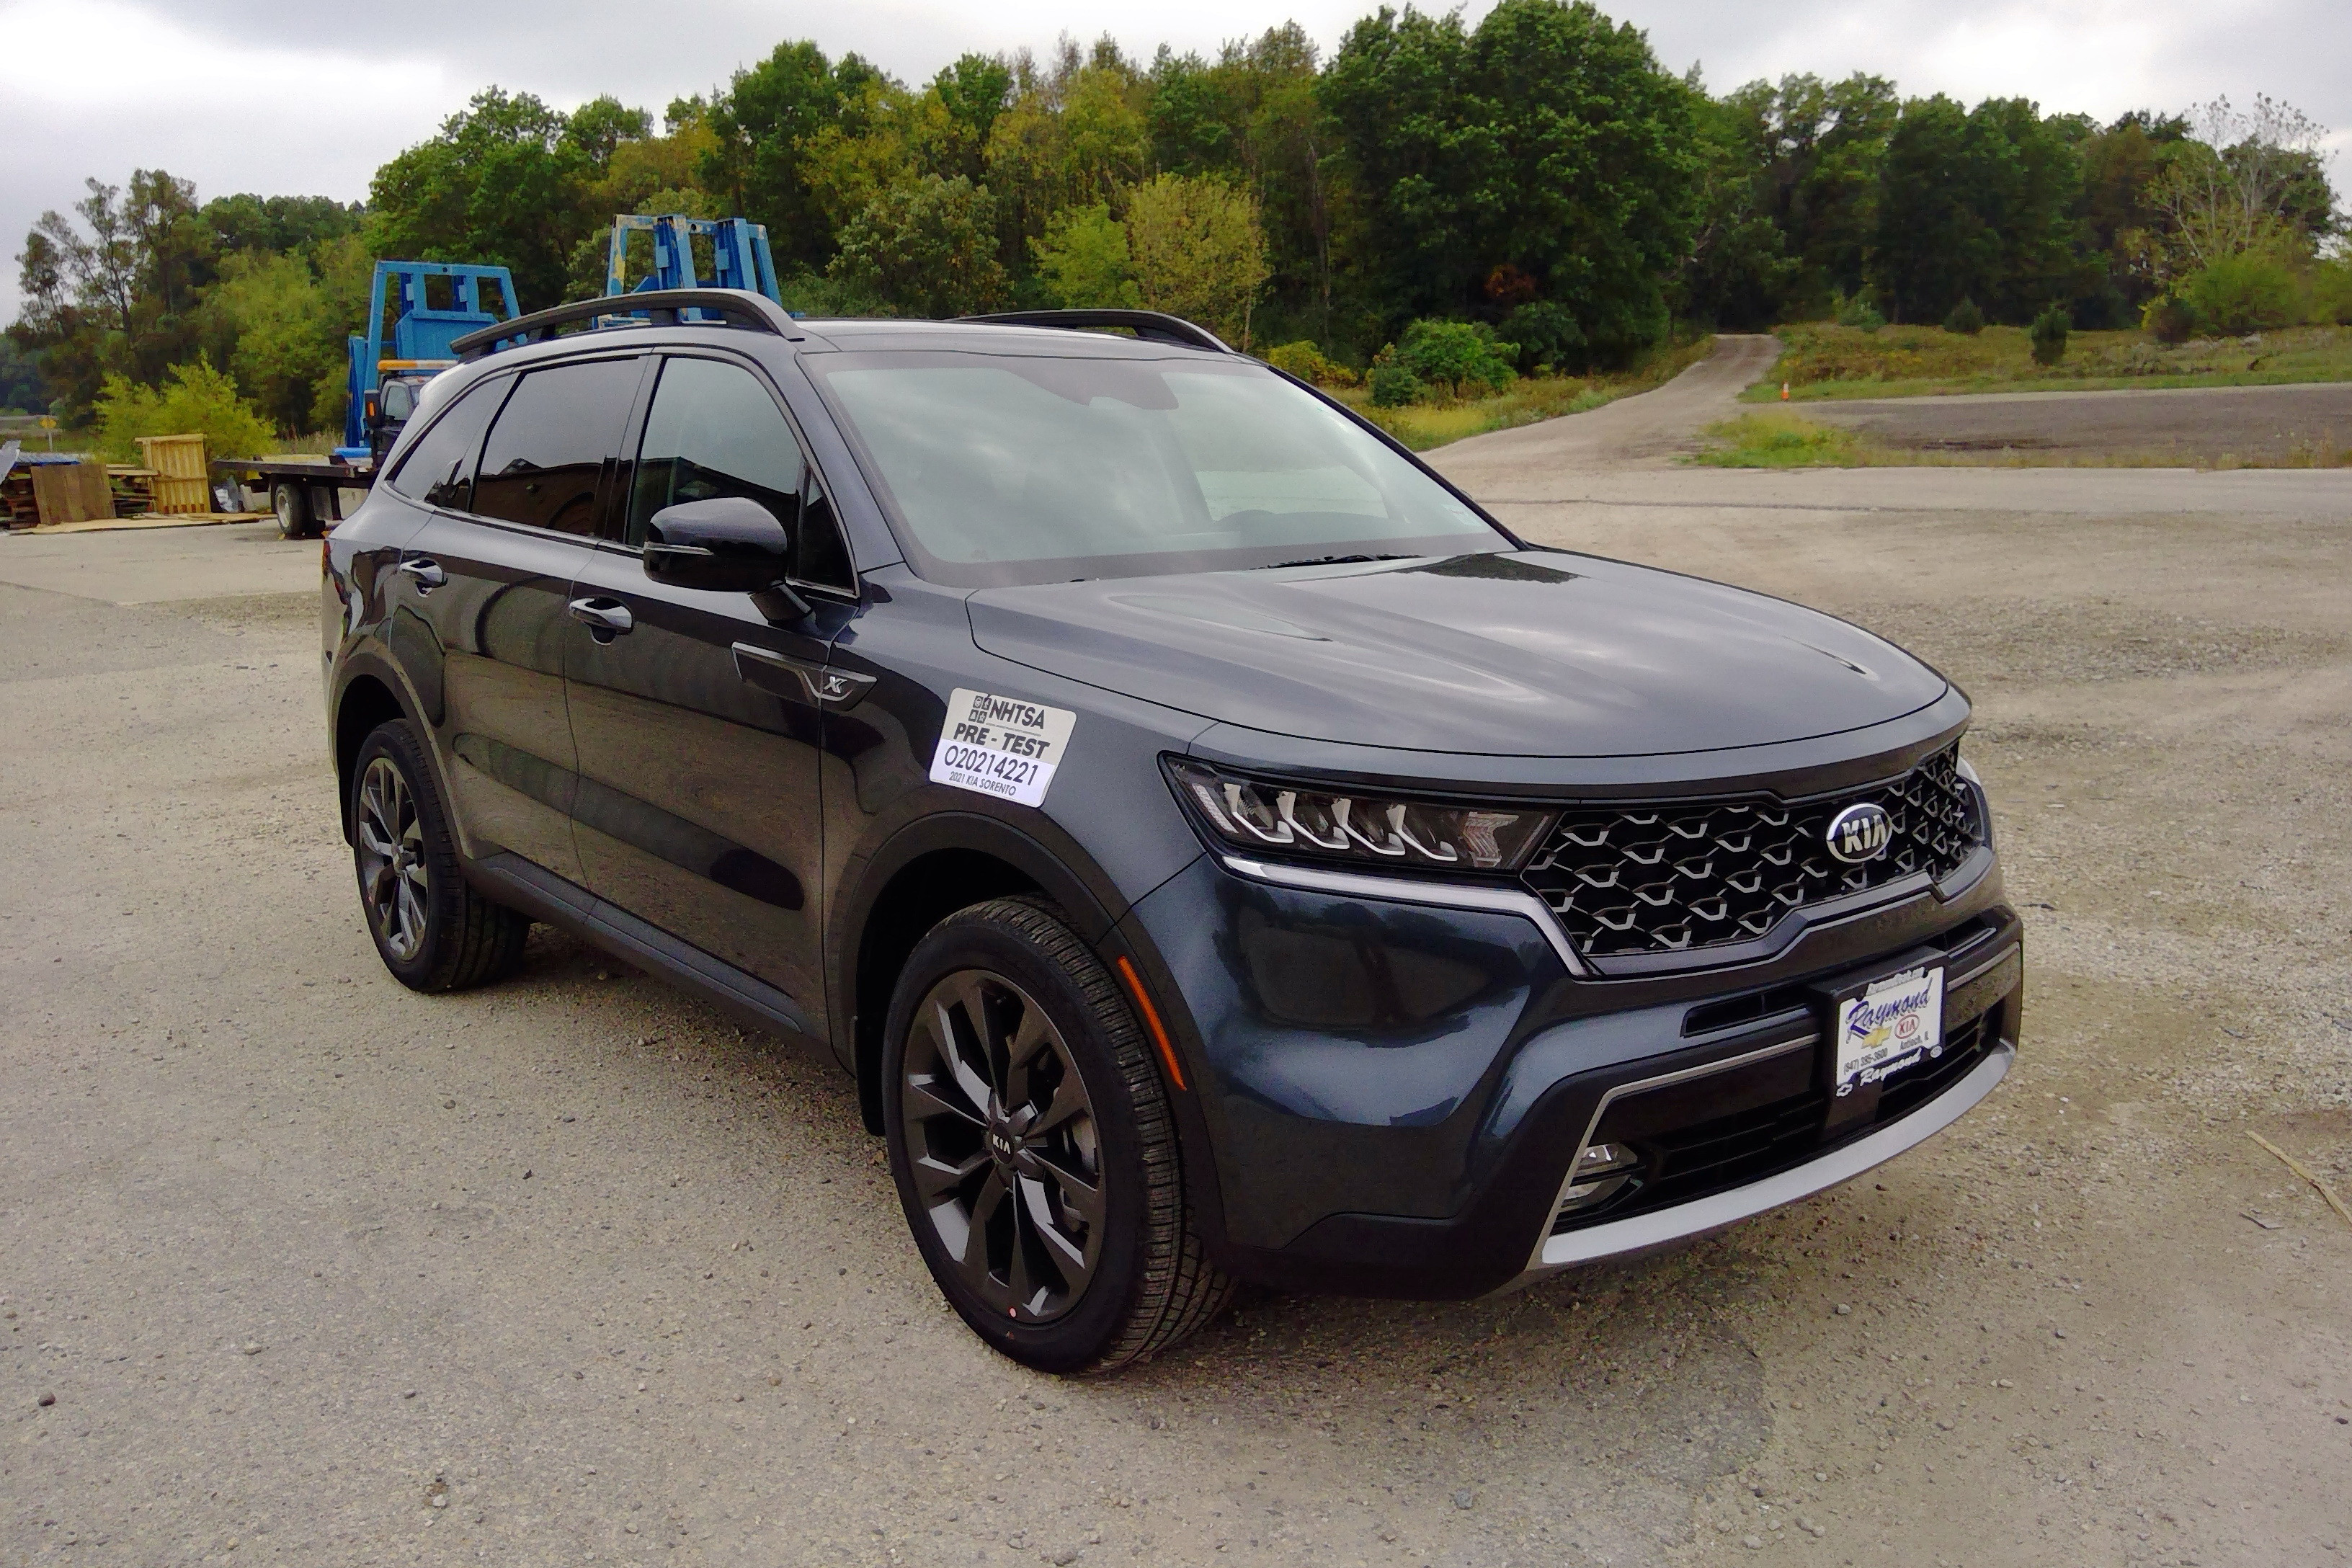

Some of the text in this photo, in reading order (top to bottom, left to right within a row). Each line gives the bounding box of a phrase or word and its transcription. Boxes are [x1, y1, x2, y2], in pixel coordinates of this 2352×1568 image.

[989, 699, 1045, 730] NHTSA
[953, 723, 990, 746] PRE
[1001, 732, 1051, 759] TEST
[948, 770, 1017, 796] 2021 KIA SORENTO
[1841, 814, 1886, 853] KIA
[1845, 977, 1933, 1044] Raymond
[1860, 1047, 1923, 1087] Raymond
[992, 1133, 1011, 1154] KIA
